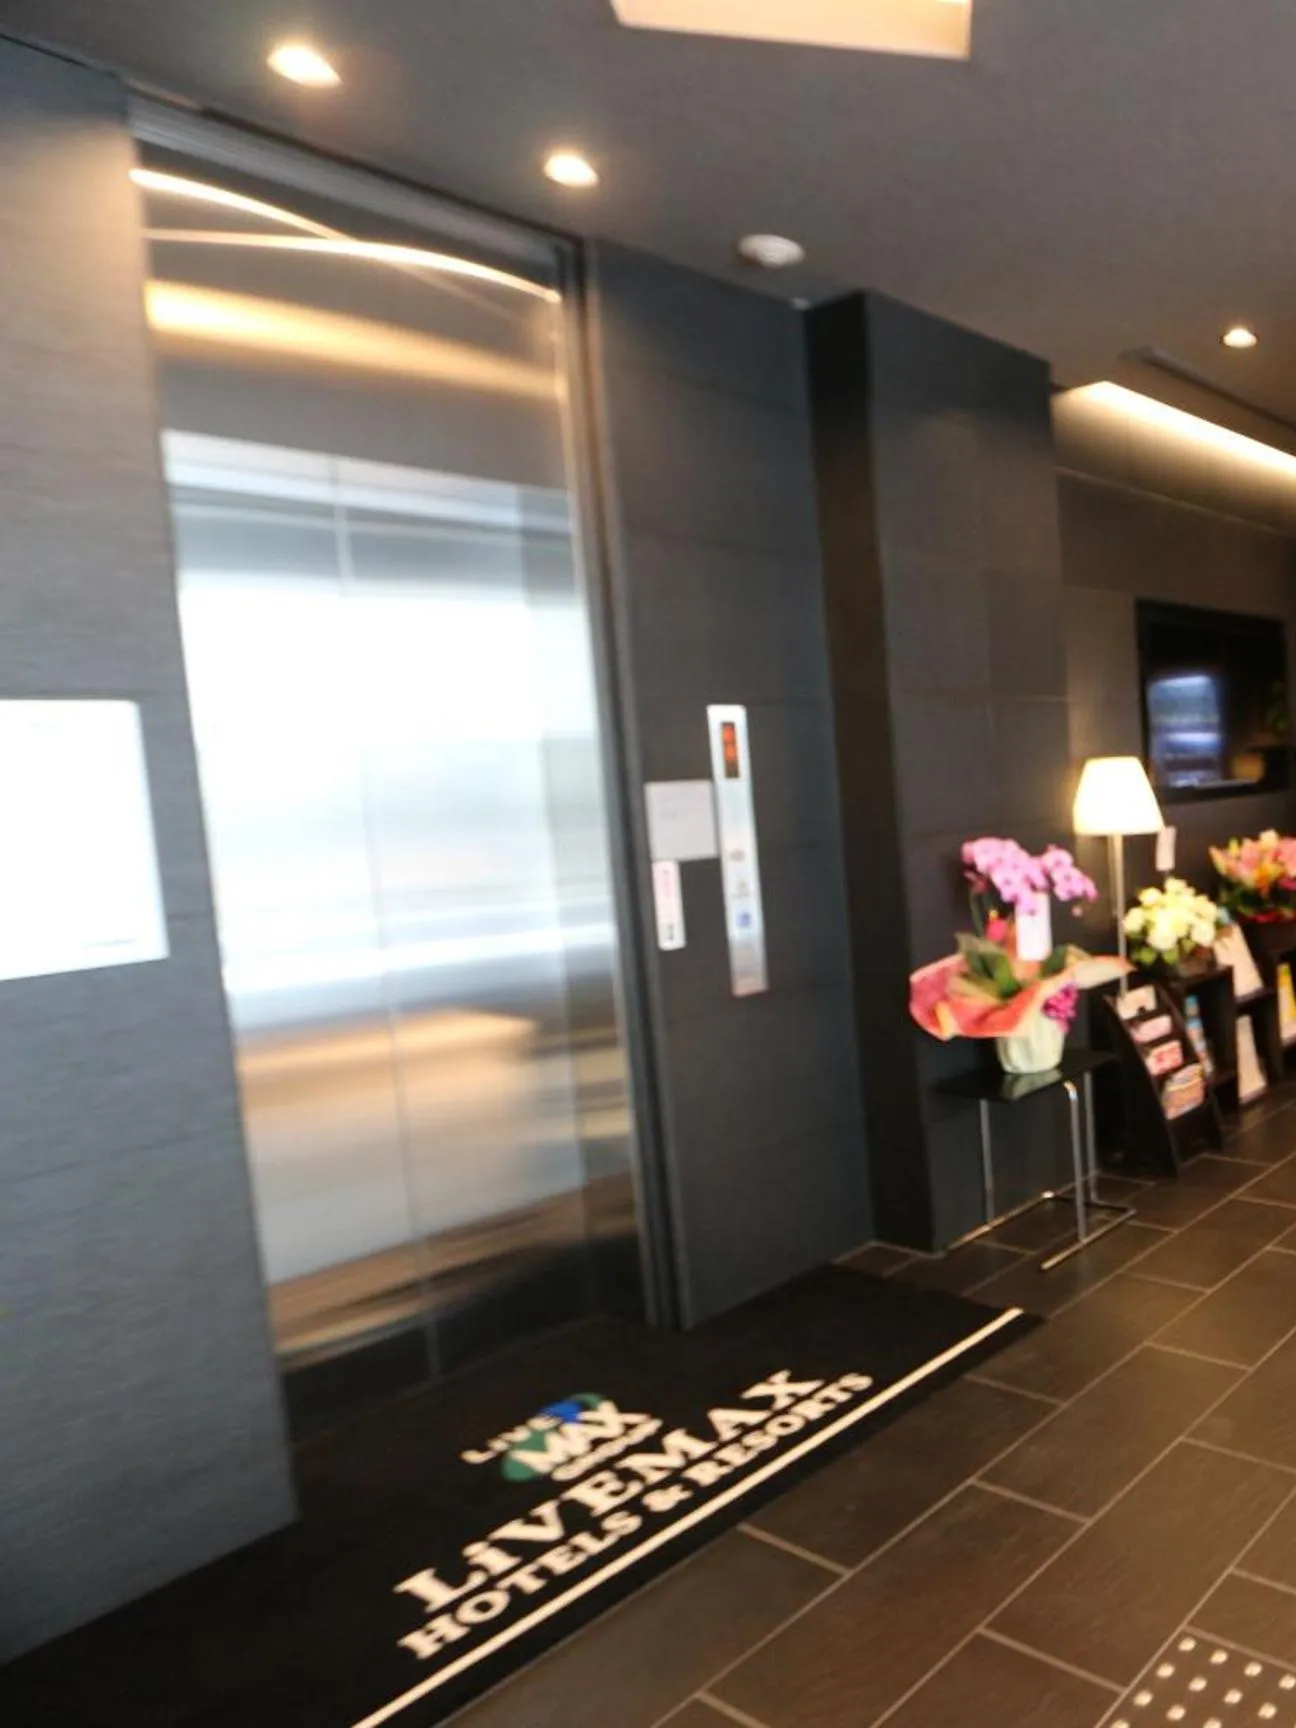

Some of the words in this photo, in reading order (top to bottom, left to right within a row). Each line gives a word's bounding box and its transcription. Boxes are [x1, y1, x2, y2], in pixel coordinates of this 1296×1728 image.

[397, 1509, 643, 1659] HOTELS
[642, 1486, 695, 1513] &
[682, 1373, 874, 1486] RESORTS
[508, 1400, 653, 1473] MAX
